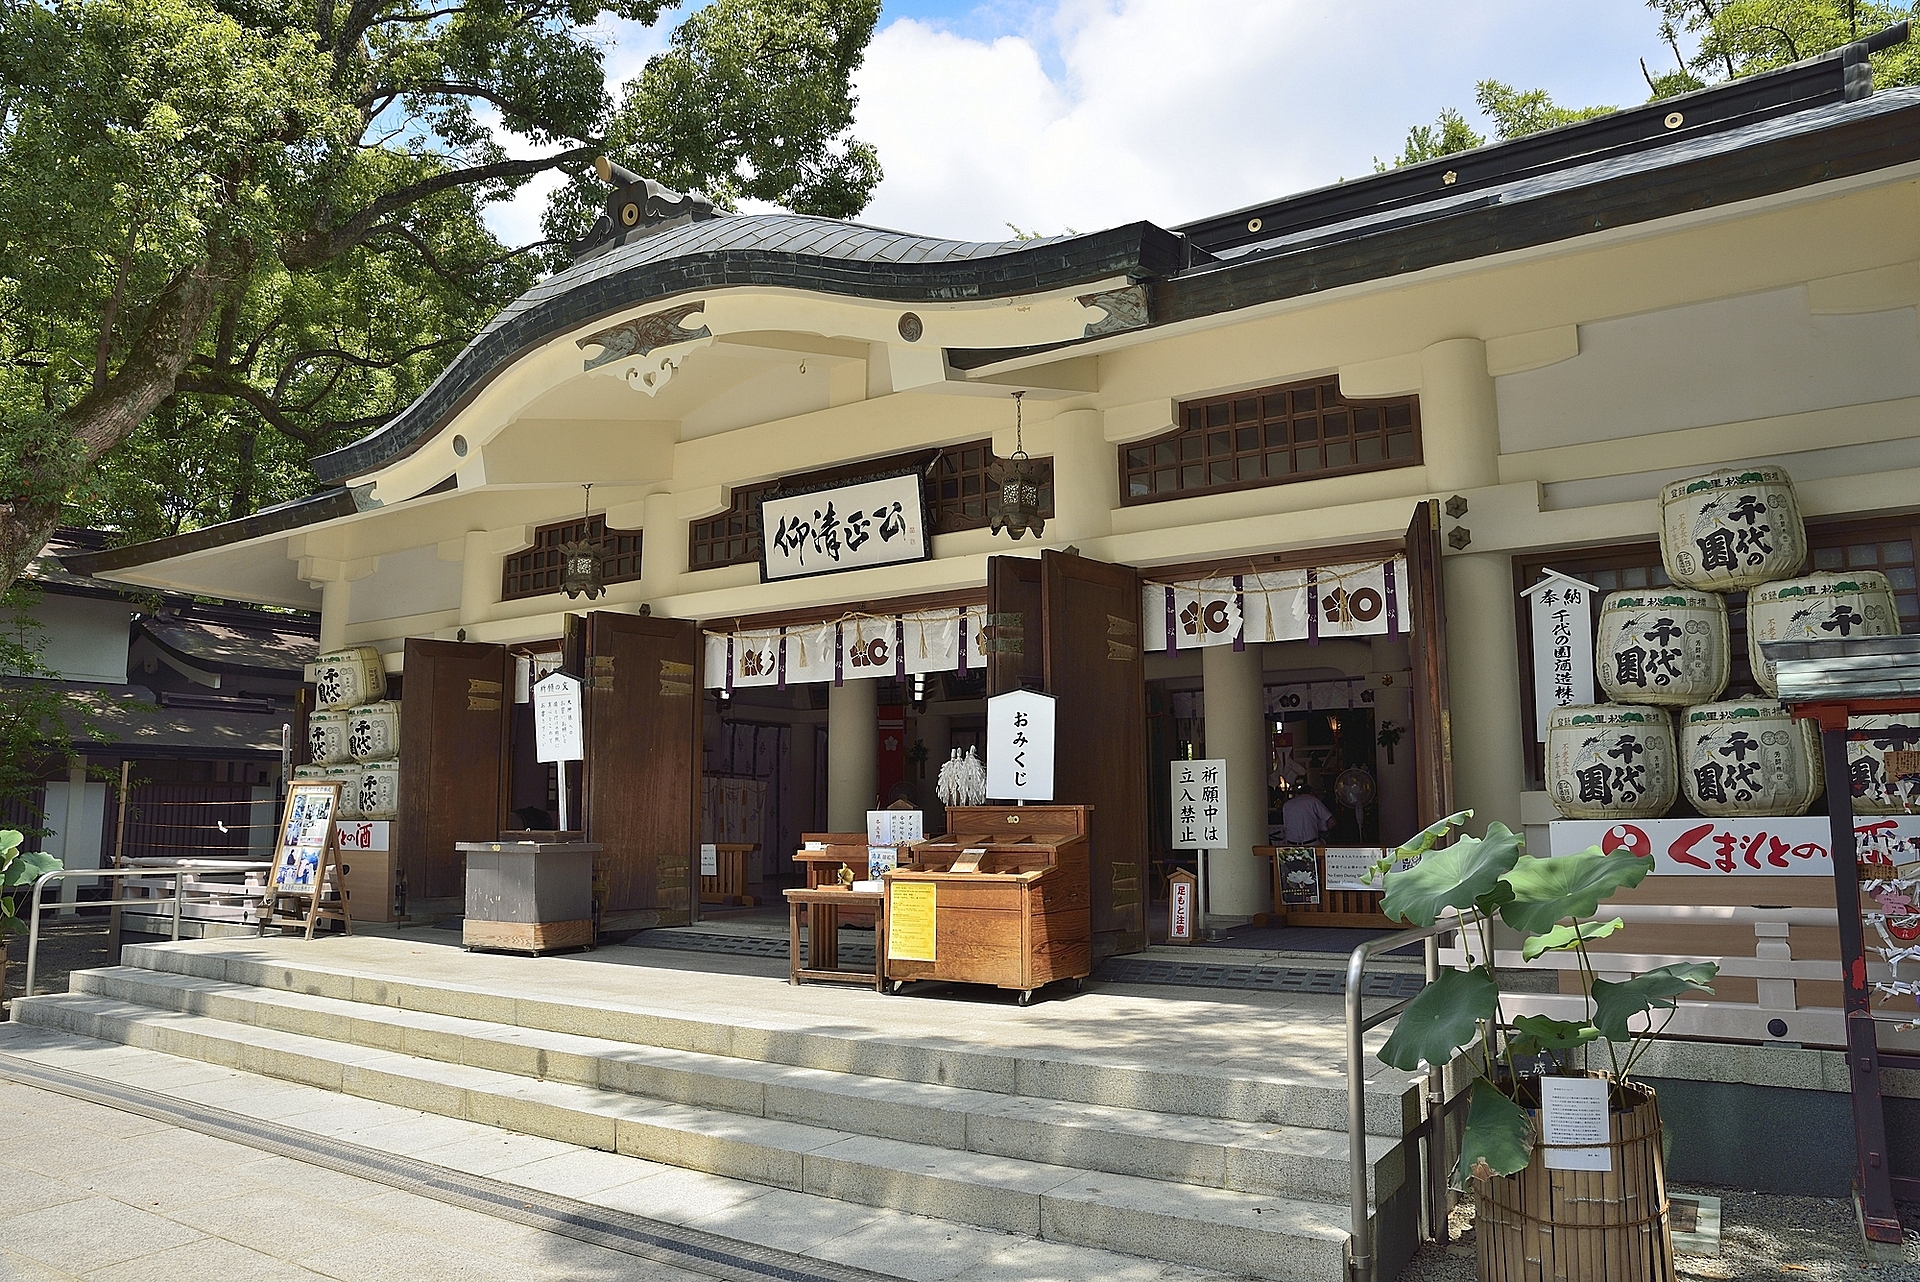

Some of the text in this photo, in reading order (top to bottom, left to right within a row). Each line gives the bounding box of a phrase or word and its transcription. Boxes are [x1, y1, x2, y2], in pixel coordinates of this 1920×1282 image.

[1540, 589, 1582, 607] 奉納
[1013, 711, 1029, 787] おみくじ
[1179, 767, 1198, 843] 立入禁止
[1201, 766, 1220, 842] 祈願中は
[1175, 885, 1186, 936] 足もと注意
